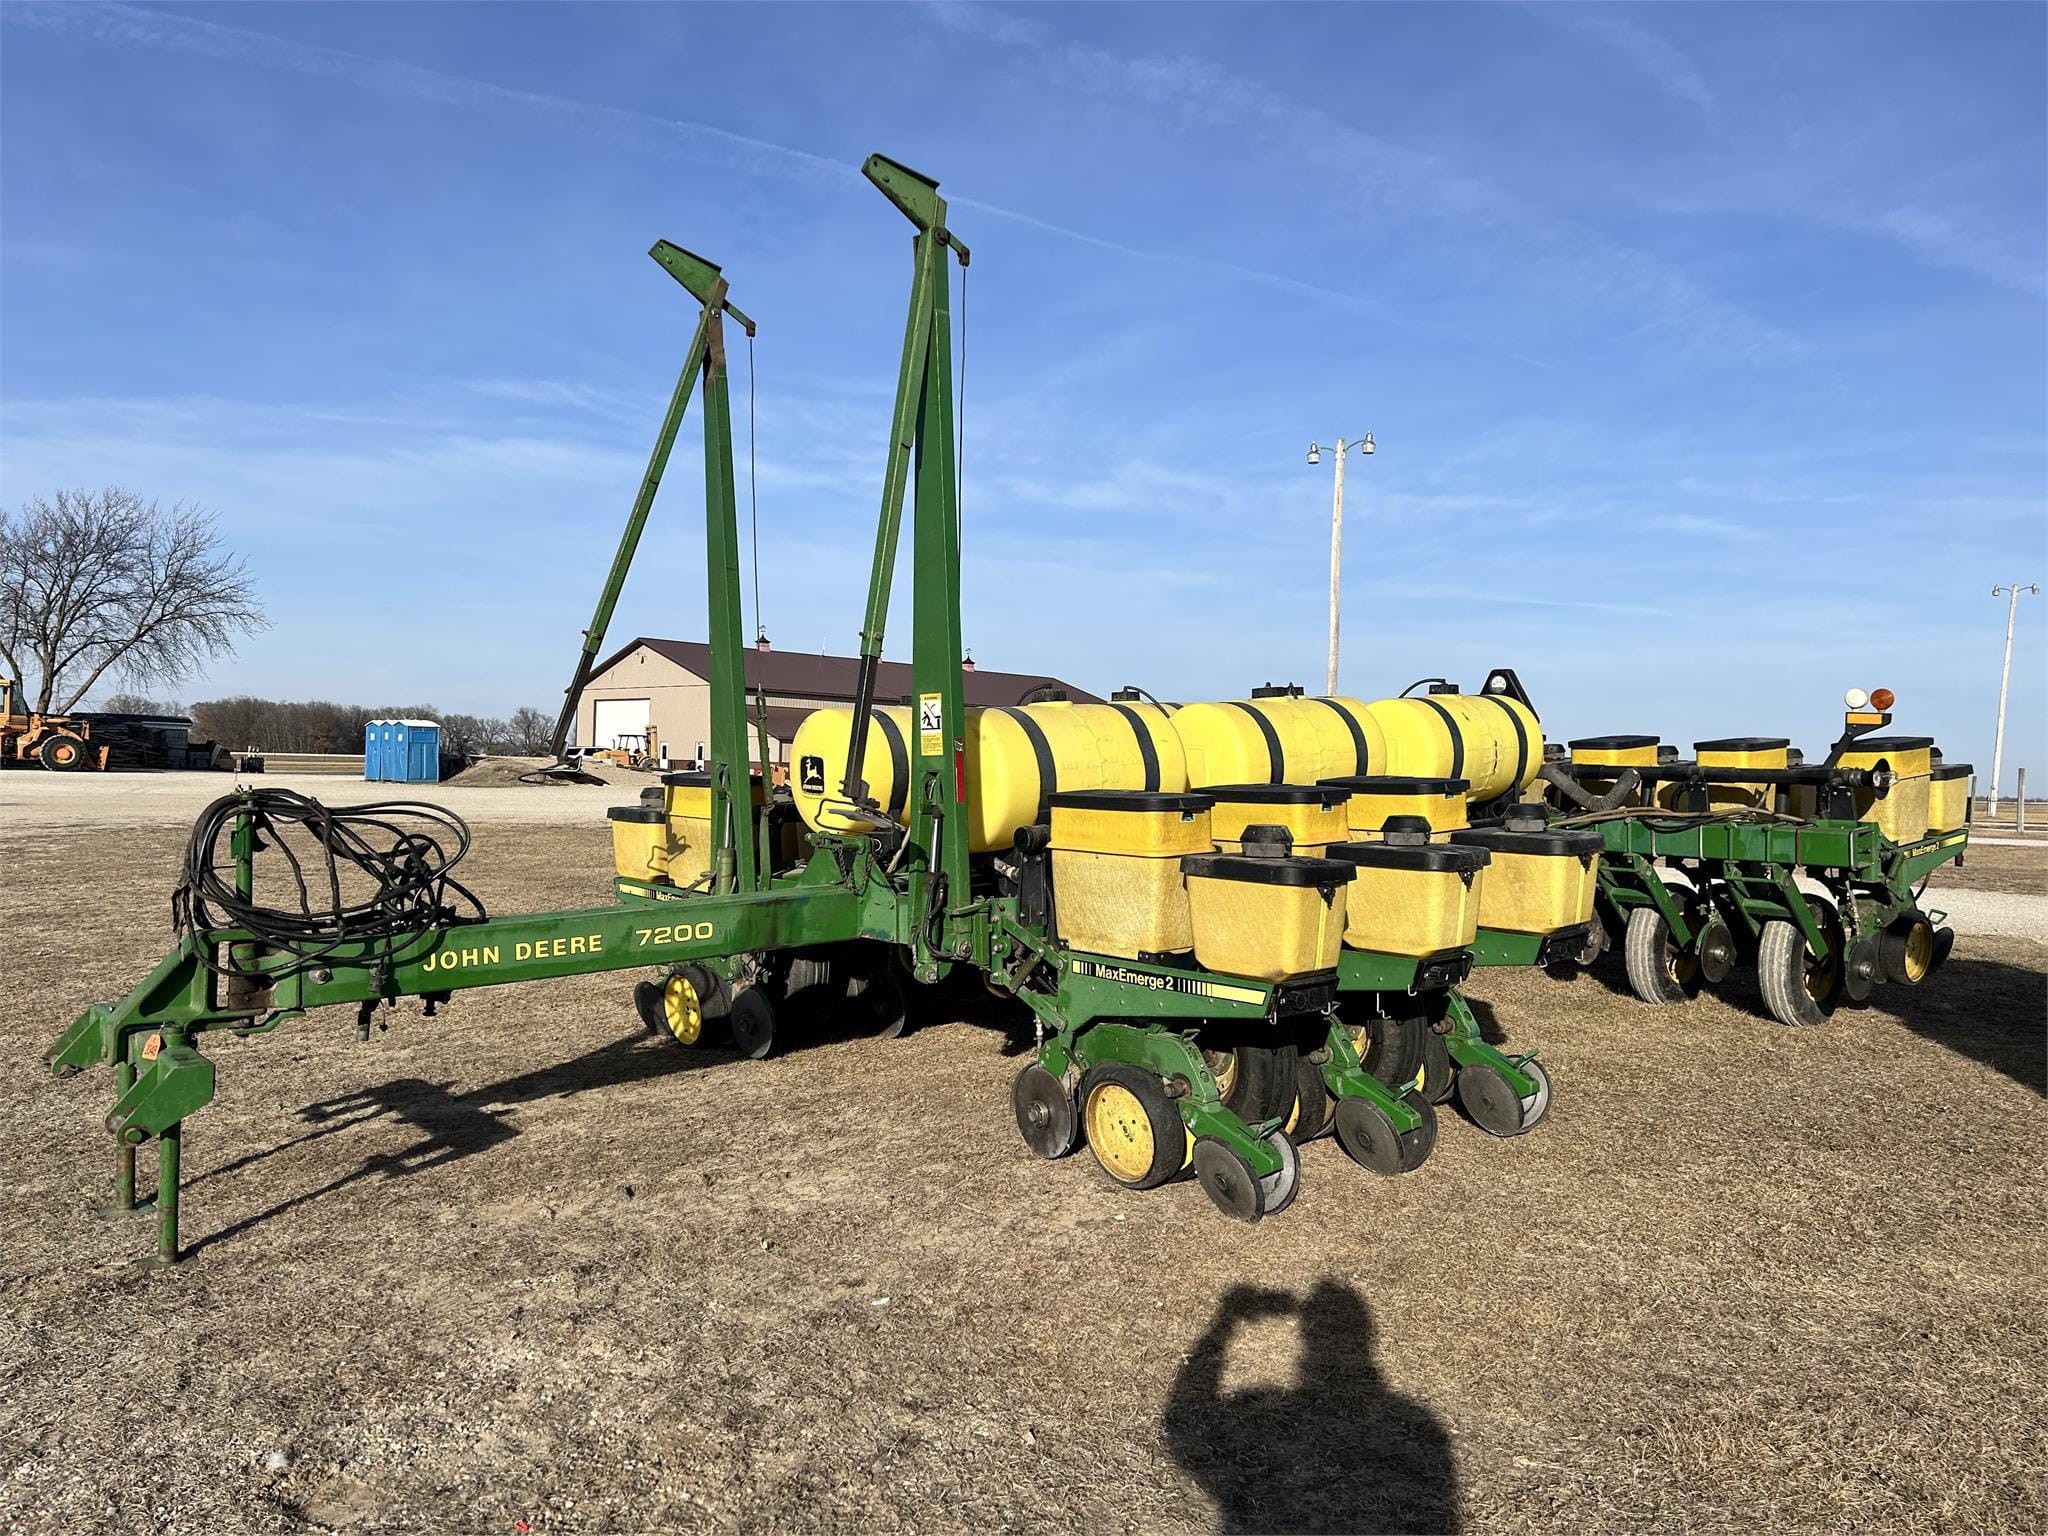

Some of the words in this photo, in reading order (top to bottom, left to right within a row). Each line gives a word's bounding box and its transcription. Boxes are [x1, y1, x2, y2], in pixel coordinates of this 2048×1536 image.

[422, 945, 501, 972] JOHN
[515, 934, 603, 961] DEERE
[635, 921, 714, 947] 7200
